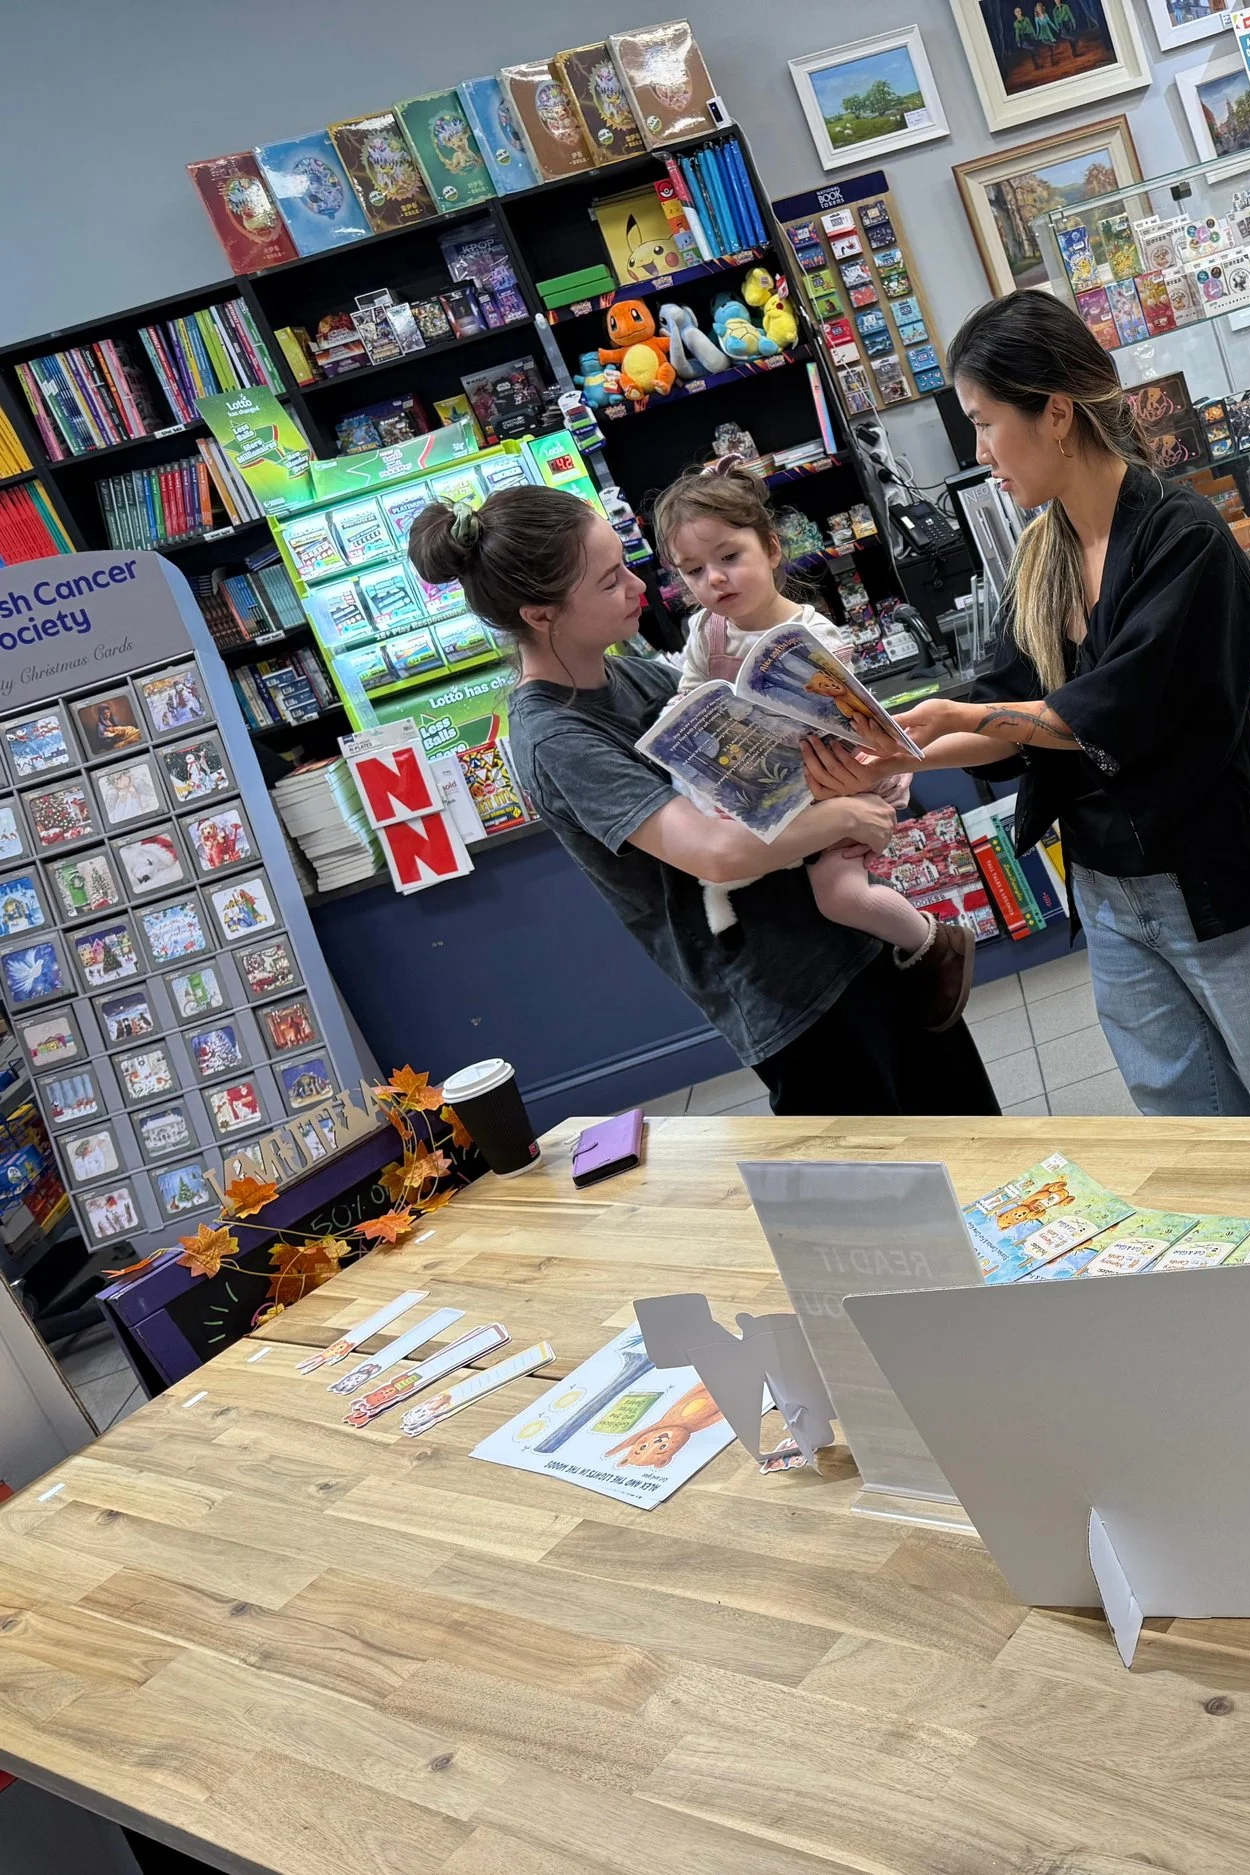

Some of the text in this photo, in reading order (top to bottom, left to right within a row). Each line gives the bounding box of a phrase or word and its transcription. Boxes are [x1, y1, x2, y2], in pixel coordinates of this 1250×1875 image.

[818, 189, 843, 203] BOOK
[820, 198, 845, 209] tokens
[226, 397, 252, 412] Lotto
[233, 423, 250, 435] Less
[237, 430, 255, 442] Balls
[236, 441, 278, 463] Millionaires
[243, 440, 263, 452] More
[33, 560, 137, 606] Cancer
[20, 636, 133, 684] Christmas Cards
[429, 690, 463, 710] Lotto
[464, 683, 489, 698] has
[420, 717, 451, 738] Less
[423, 728, 457, 751] Balls
[355, 747, 433, 822] N
[384, 813, 459, 885] N
[544, 1461, 568, 1471] WOODS
[566, 1465, 580, 1474] THE
[586, 1470, 612, 1483] LIGHTS
[610, 1475, 625, 1485] THE
[624, 1478, 640, 1488] AND
[640, 1481, 661, 1492] ALEX
